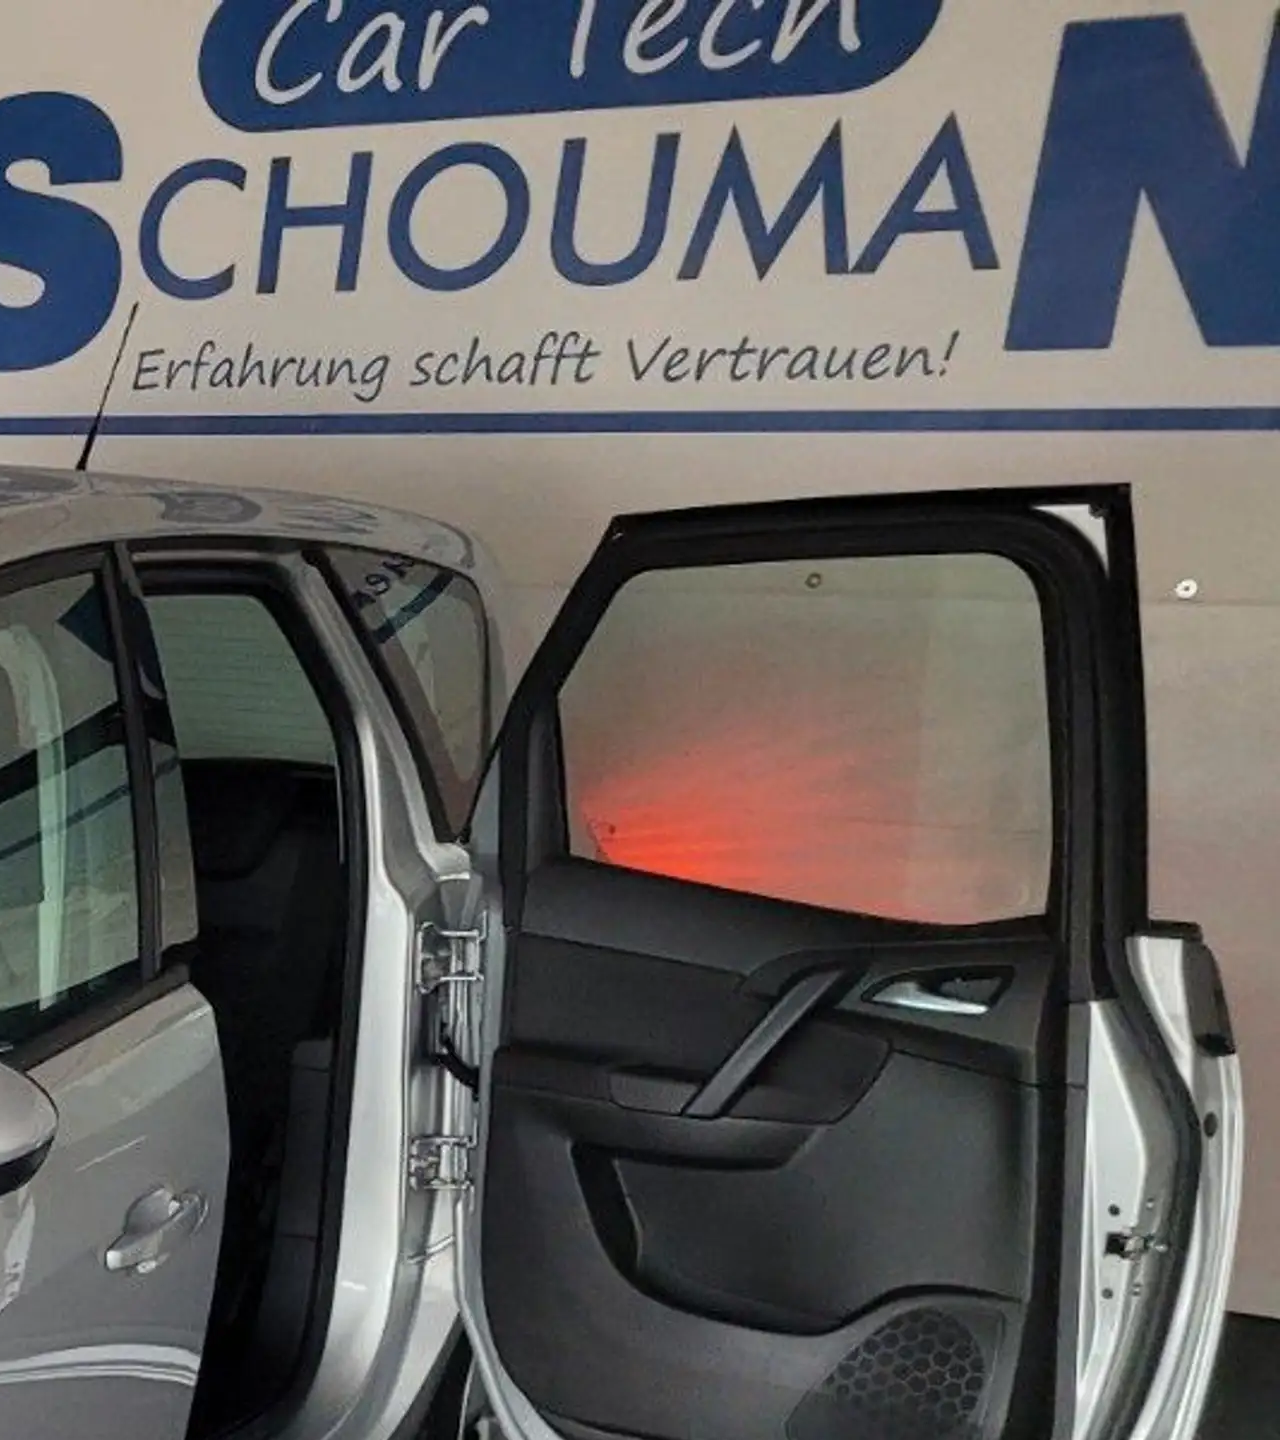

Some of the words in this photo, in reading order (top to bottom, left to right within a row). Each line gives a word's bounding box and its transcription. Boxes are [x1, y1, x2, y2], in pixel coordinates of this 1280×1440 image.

[253, 0, 490, 104] Car
[131, 337, 391, 402] Erfahrung
[408, 330, 603, 386] schafft
[627, 330, 960, 383] Vertrauen!
